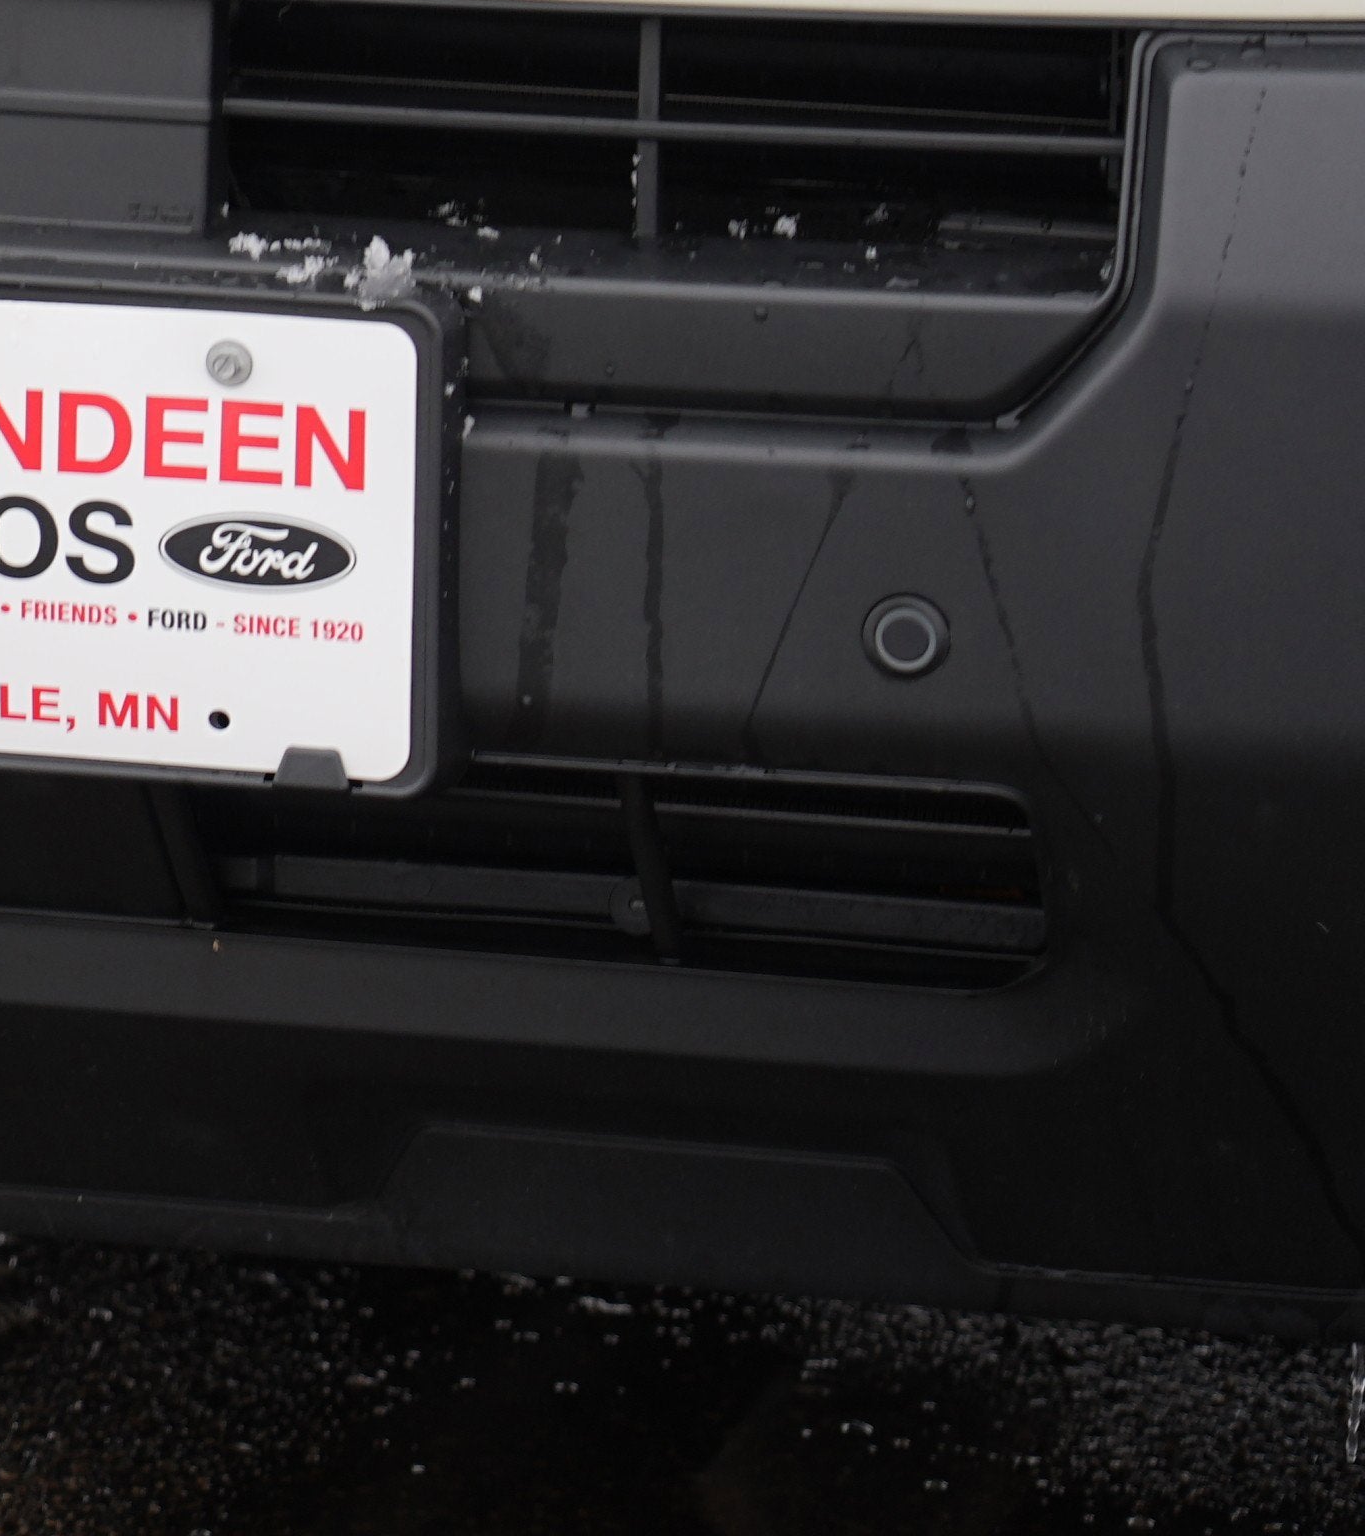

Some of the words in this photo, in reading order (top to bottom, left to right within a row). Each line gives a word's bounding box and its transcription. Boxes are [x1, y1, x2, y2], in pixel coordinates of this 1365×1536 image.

[198, 521, 320, 581] Ford
[20, 600, 119, 627] FRIENDS
[146, 608, 208, 632] FORD
[232, 613, 301, 638] SINCE
[310, 619, 365, 643] 1920
[96, 690, 180, 733] MN
